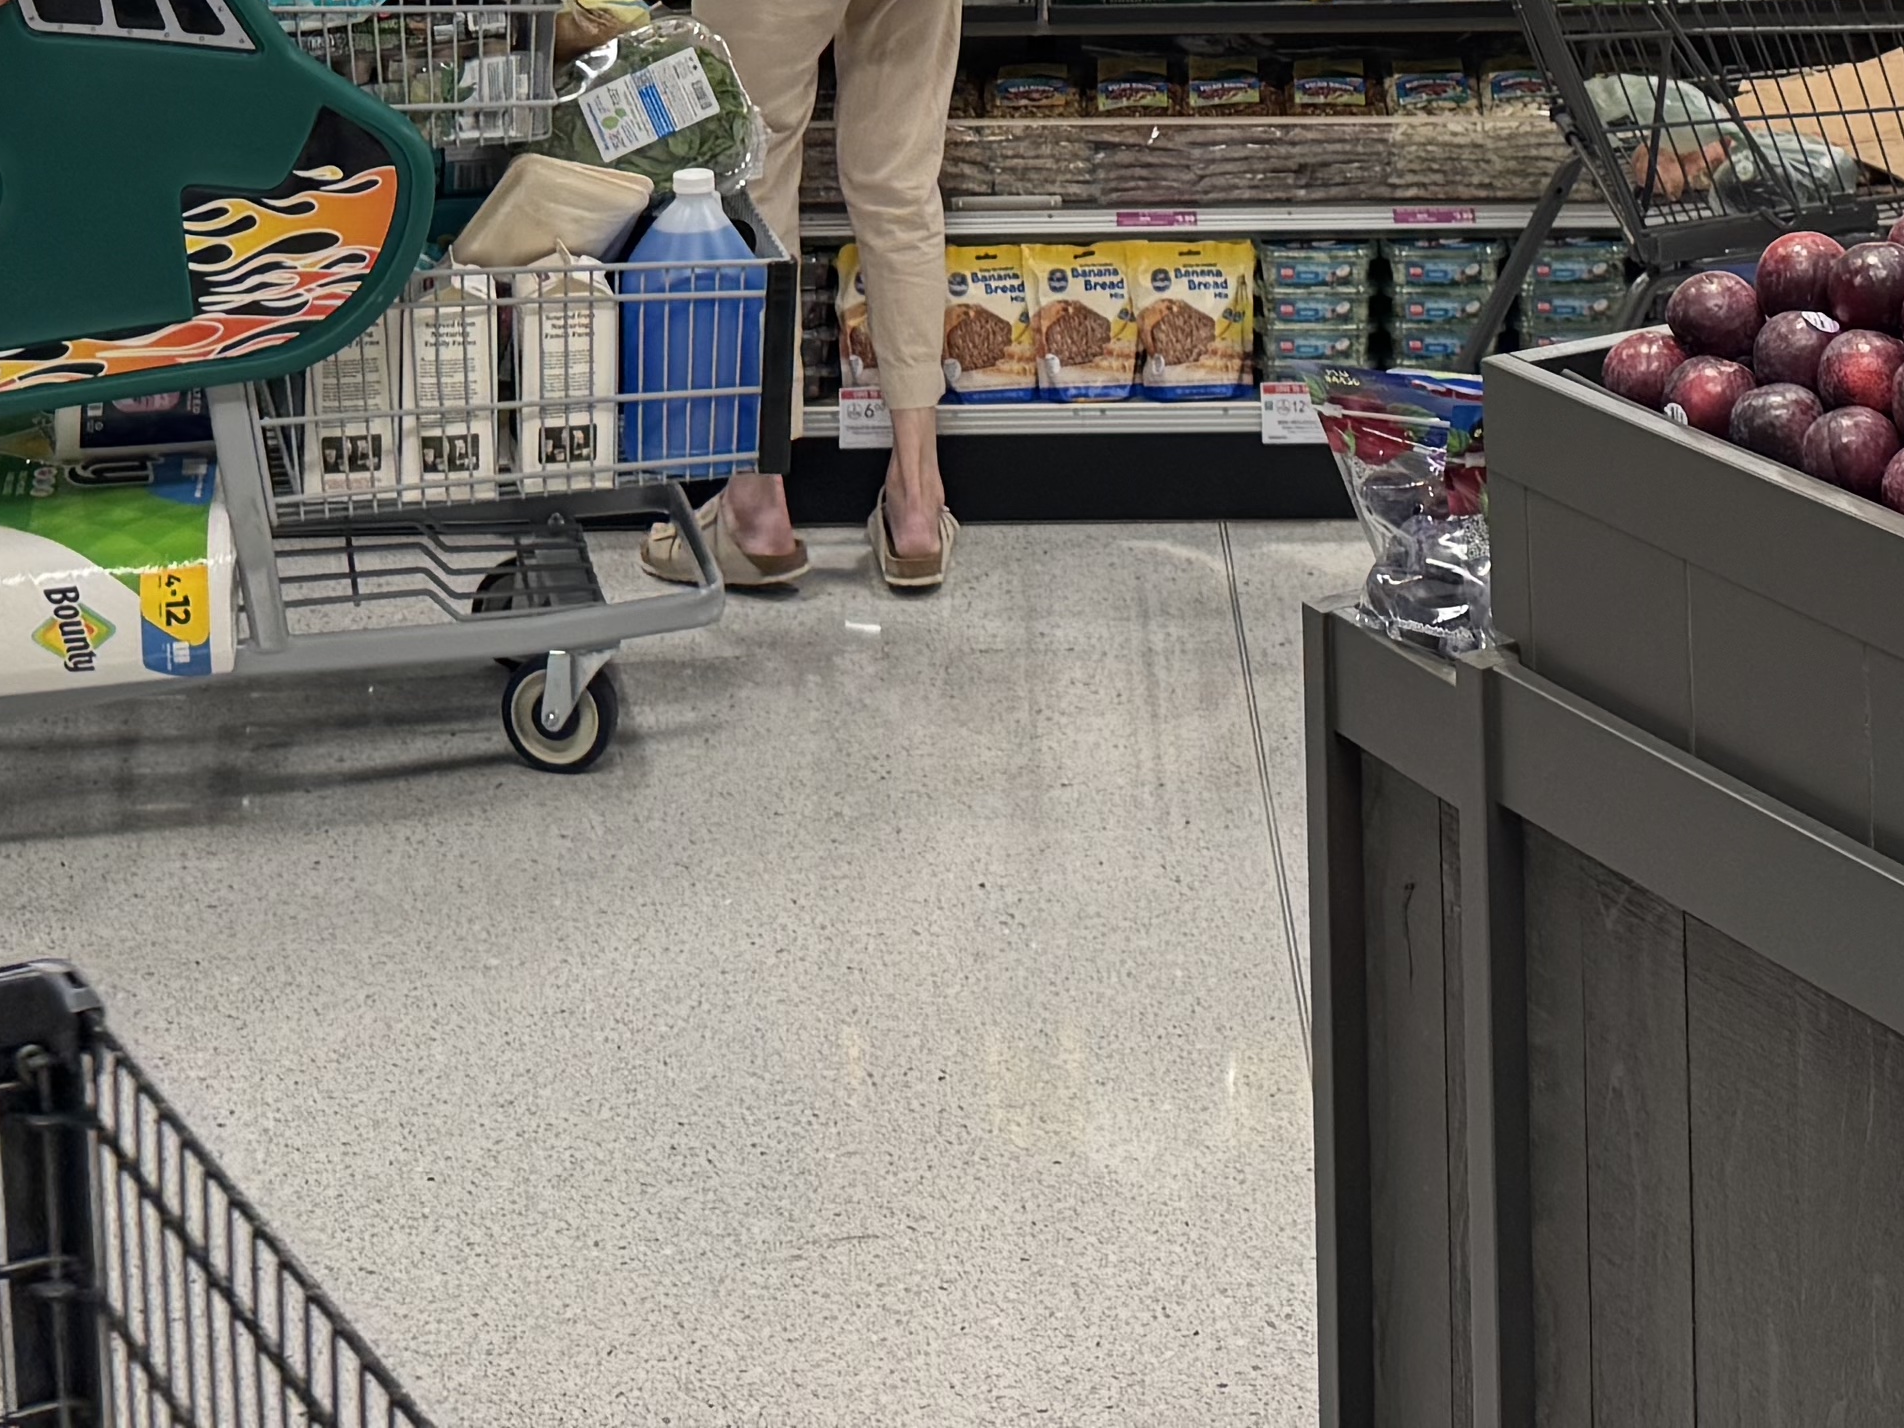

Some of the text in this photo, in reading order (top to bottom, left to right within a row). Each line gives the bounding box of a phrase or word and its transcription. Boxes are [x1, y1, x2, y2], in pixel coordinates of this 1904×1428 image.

[971, 270, 1021, 285] Banana
[1071, 266, 1120, 280] Banana
[1174, 266, 1223, 280] Banana
[984, 280, 1026, 295] Bread
[1084, 278, 1125, 292] Bread
[1187, 278, 1229, 292] Bread
[43, 585, 96, 673] Bounty
